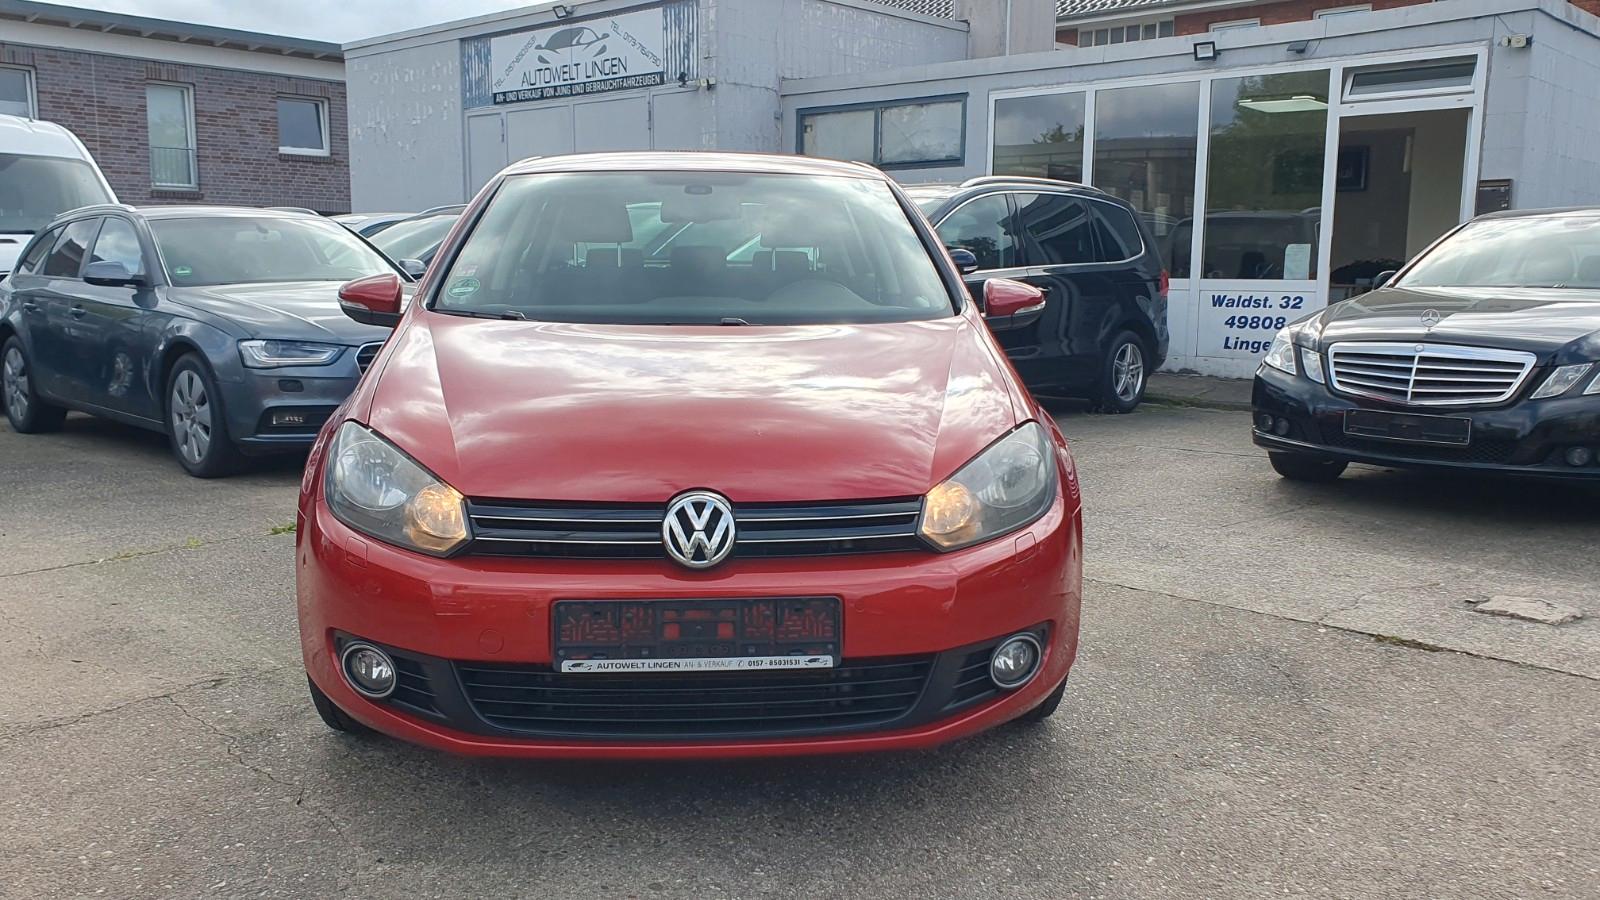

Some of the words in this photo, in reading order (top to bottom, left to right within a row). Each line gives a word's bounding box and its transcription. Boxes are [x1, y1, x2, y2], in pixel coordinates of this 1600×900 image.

[520, 63, 581, 87] AUTOWELT
[585, 55, 628, 79] LINGEN
[505, 91, 518, 102] UND
[517, 88, 542, 101] VERKAUF
[543, 87, 555, 98] VON
[555, 85, 572, 97] JUNG
[571, 83, 585, 94] UND
[585, 74, 660, 93] GEBRAUCHTFAHRZEUGEN
[1211, 294, 1273, 309] Waldst.
[1279, 295, 1304, 309] 32
[1224, 315, 1286, 330] 49808
[1223, 336, 1271, 353] Linge
[596, 662, 646, 670] AUTOWELT
[647, 661, 681, 669] LINGEN
[703, 661, 733, 669] VERKAUF
